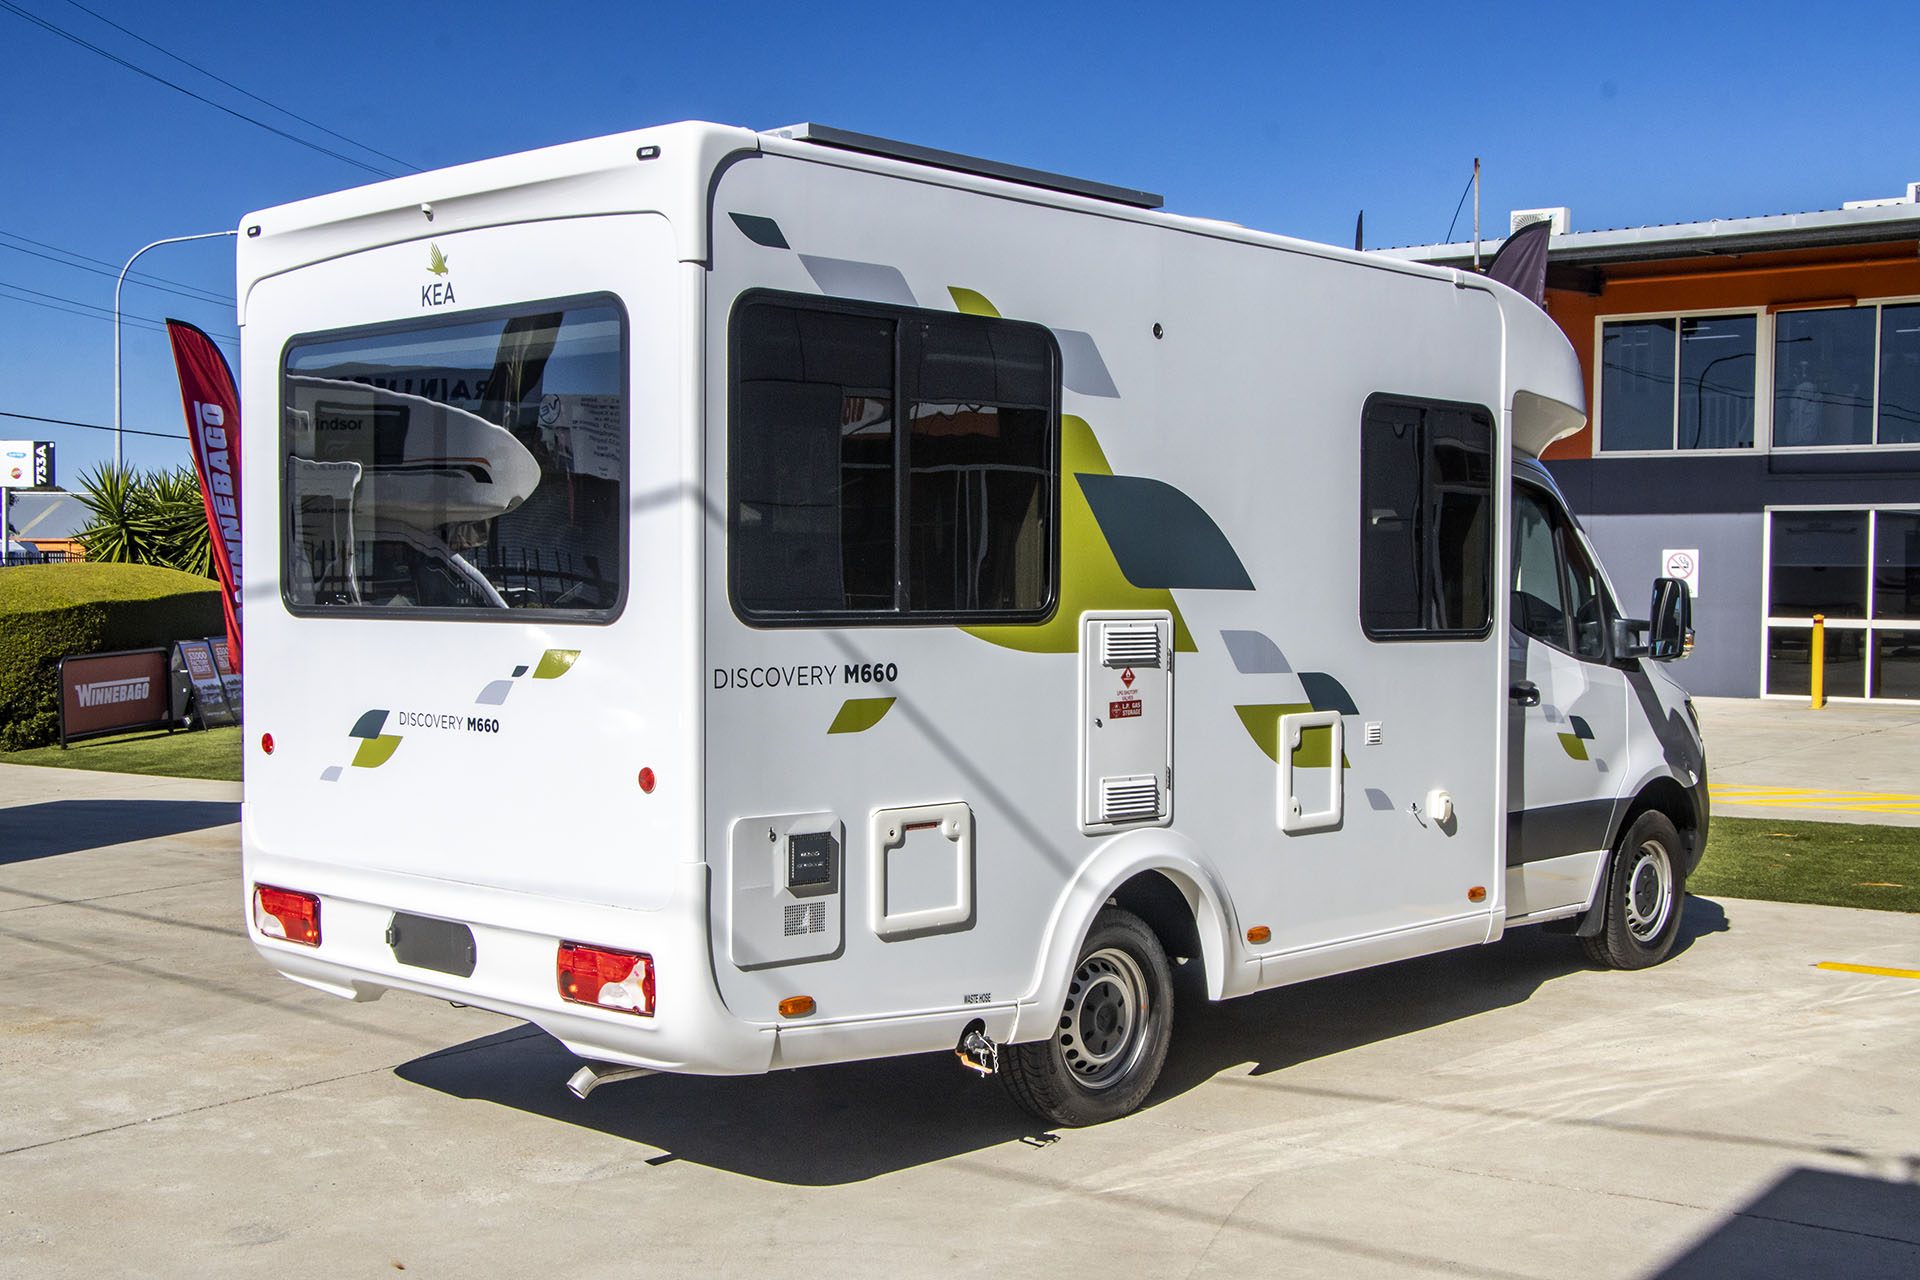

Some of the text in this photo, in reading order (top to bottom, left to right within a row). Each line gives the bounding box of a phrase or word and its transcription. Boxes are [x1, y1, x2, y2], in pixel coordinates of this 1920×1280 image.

[421, 281, 456, 307] KEA
[35, 444, 48, 485] 733A
[196, 401, 242, 624] NNEBAGO
[714, 662, 898, 689] DISCOVERY M660
[75, 676, 150, 708] WINNEBAGO
[399, 711, 500, 733] DISCOVERY M660
